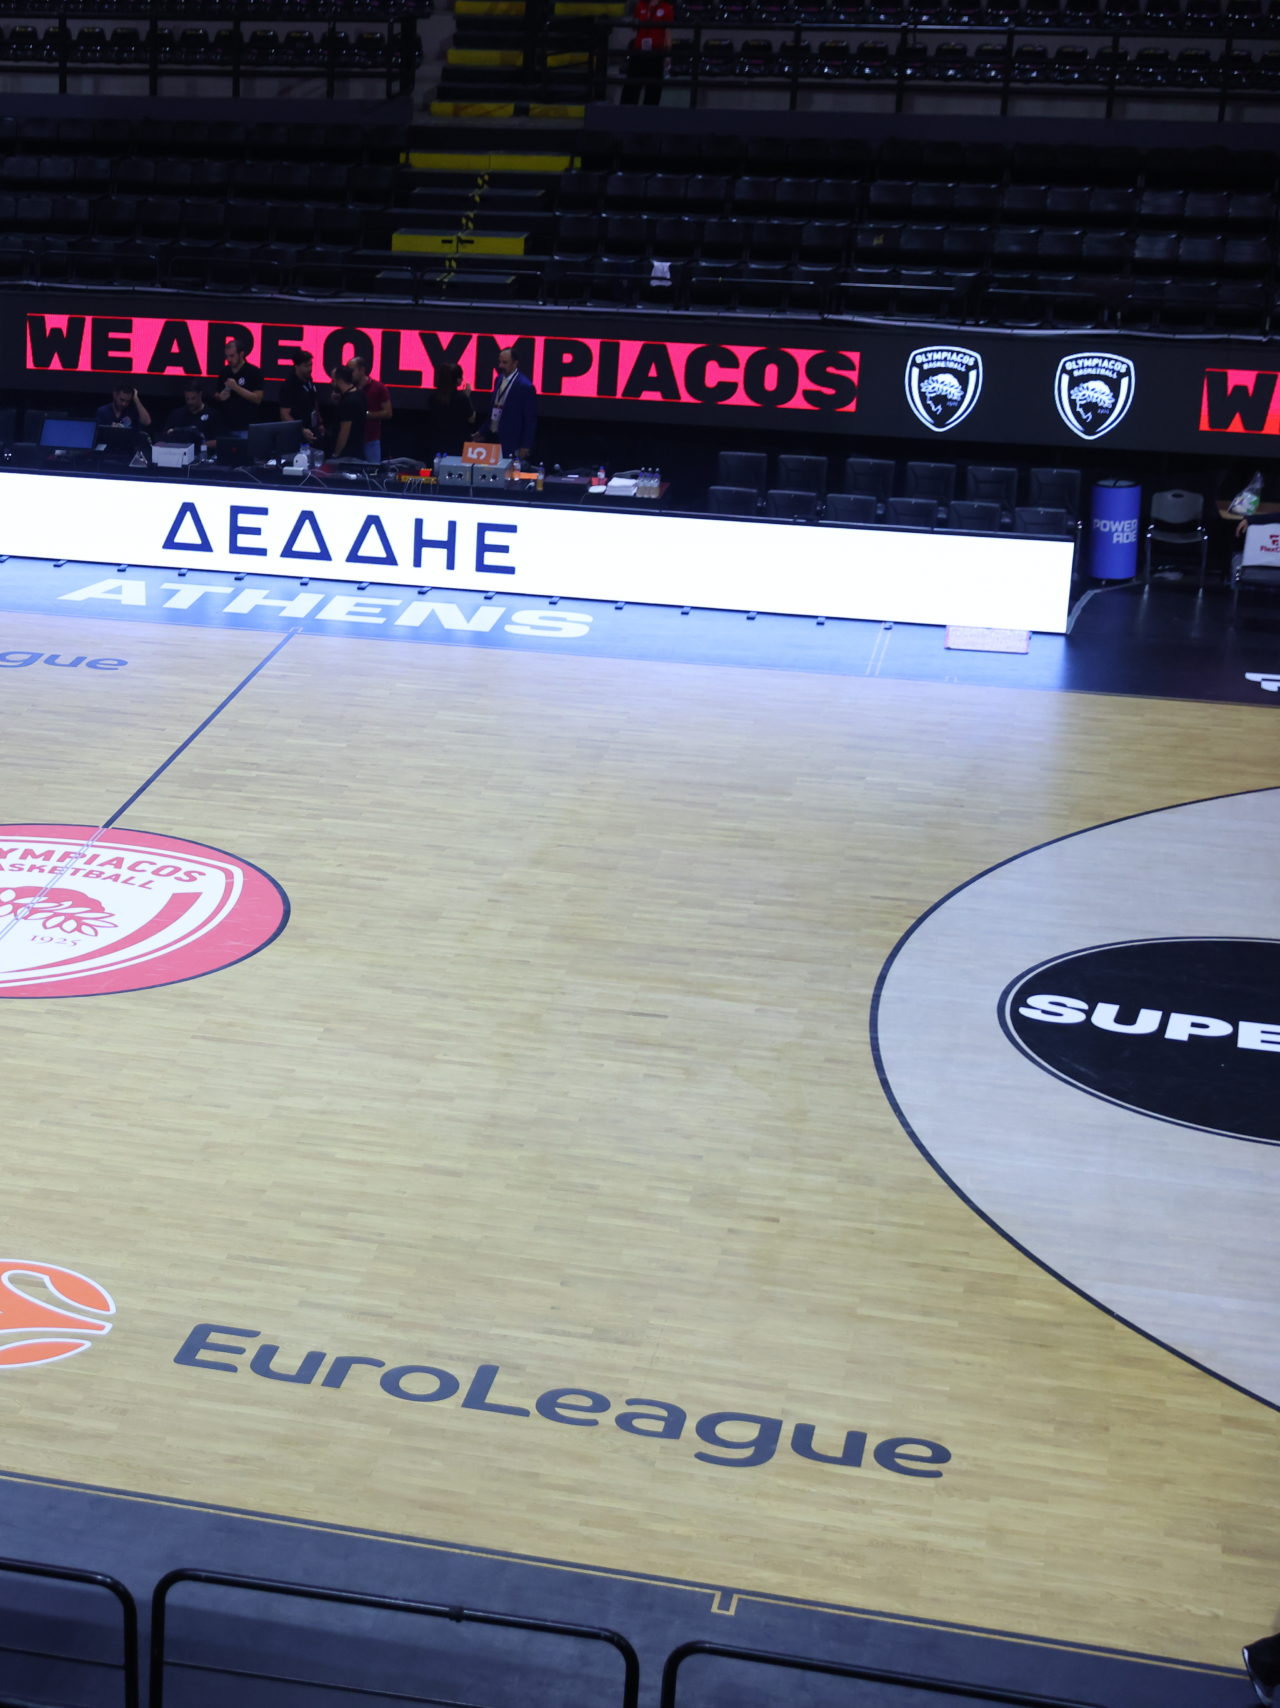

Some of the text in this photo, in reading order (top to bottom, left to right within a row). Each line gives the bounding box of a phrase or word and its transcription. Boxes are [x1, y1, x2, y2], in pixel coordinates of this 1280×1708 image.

[27, 315, 133, 372] WE
[322, 327, 858, 411] OLYMPIACOS
[915, 350, 976, 366] OLYMPIACOS
[1065, 357, 1128, 373] OLYMPIACOS
[1205, 370, 1280, 433] W
[162, 501, 518, 575] ΔΕΔΔΗΕ
[1093, 518, 1138, 533] POWER
[58, 577, 594, 639] ATHENS
[30, 933, 83, 948] 1925
[172, 1322, 953, 1479] EuroLeague
